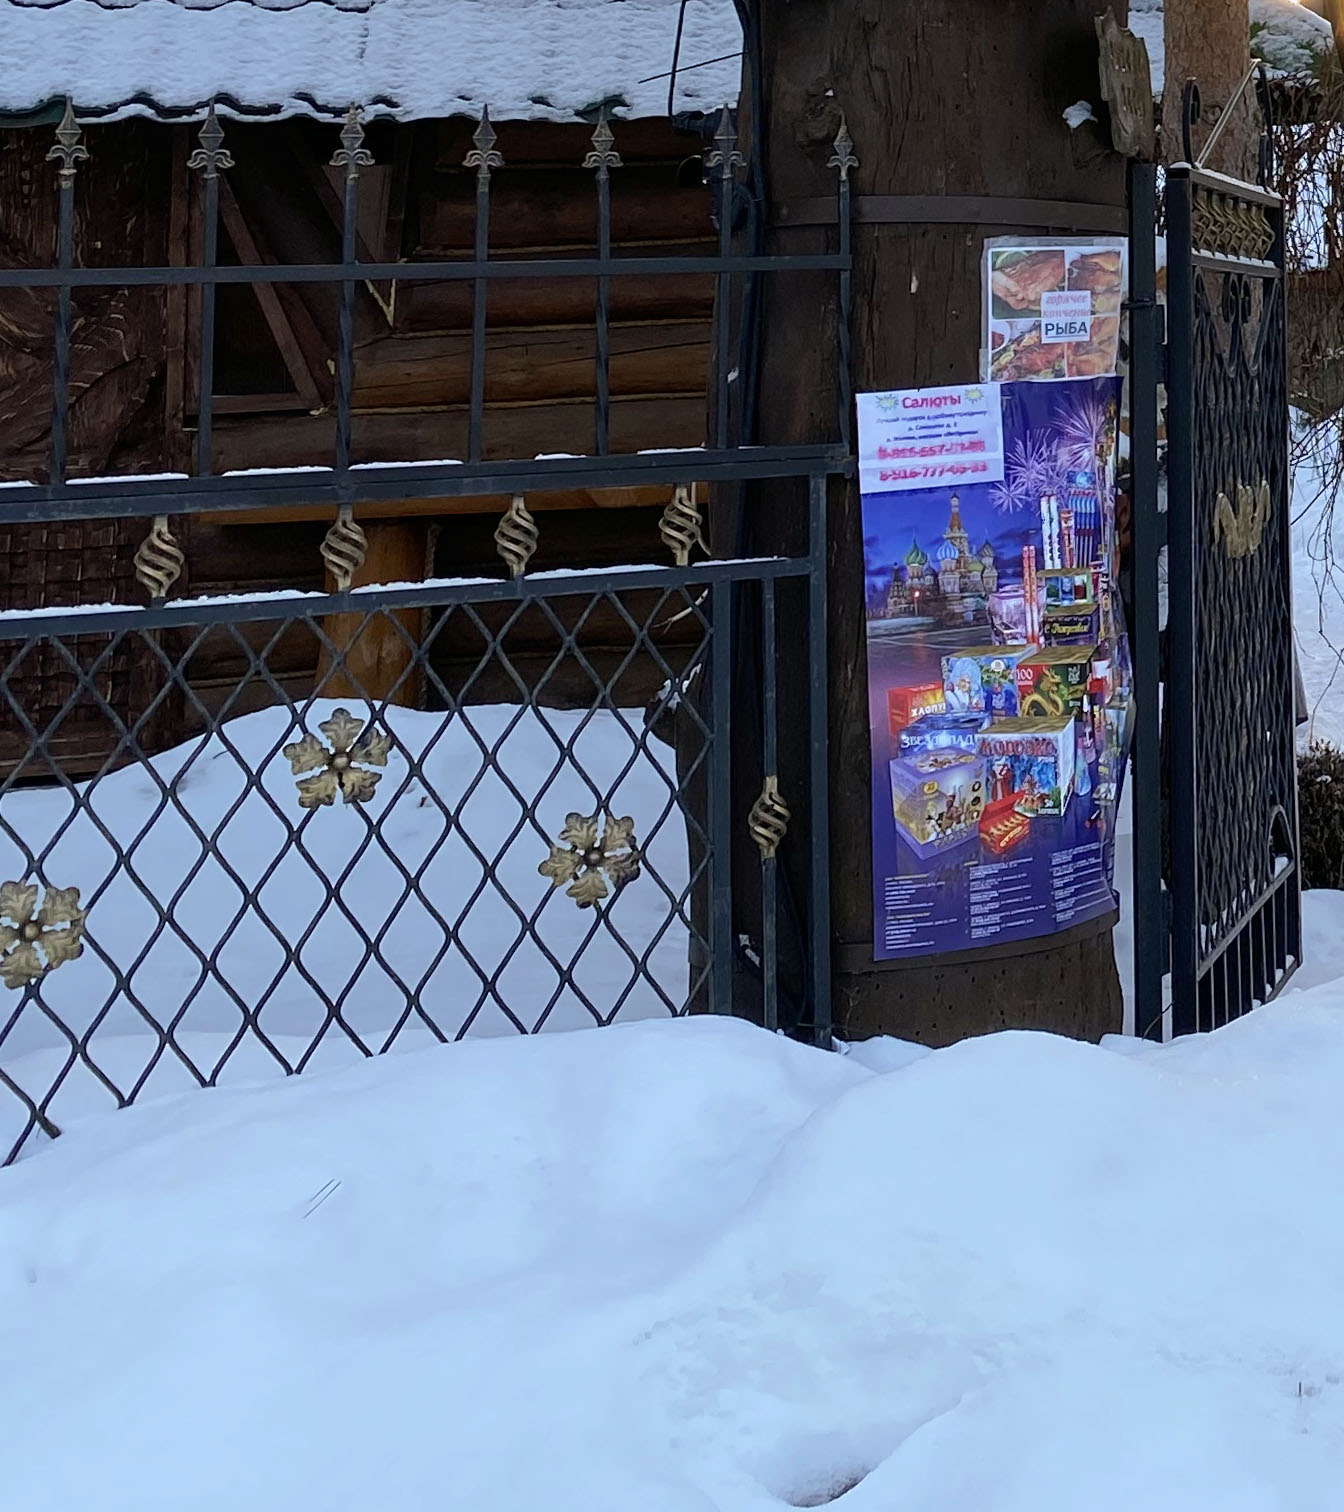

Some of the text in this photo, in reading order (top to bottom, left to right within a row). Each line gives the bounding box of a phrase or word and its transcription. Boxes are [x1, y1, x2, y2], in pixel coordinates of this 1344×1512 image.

[1044, 321, 1088, 335] РЫБА
[902, 395, 962, 409] Салюты
[911, 702, 946, 718] ХЛОПУ
